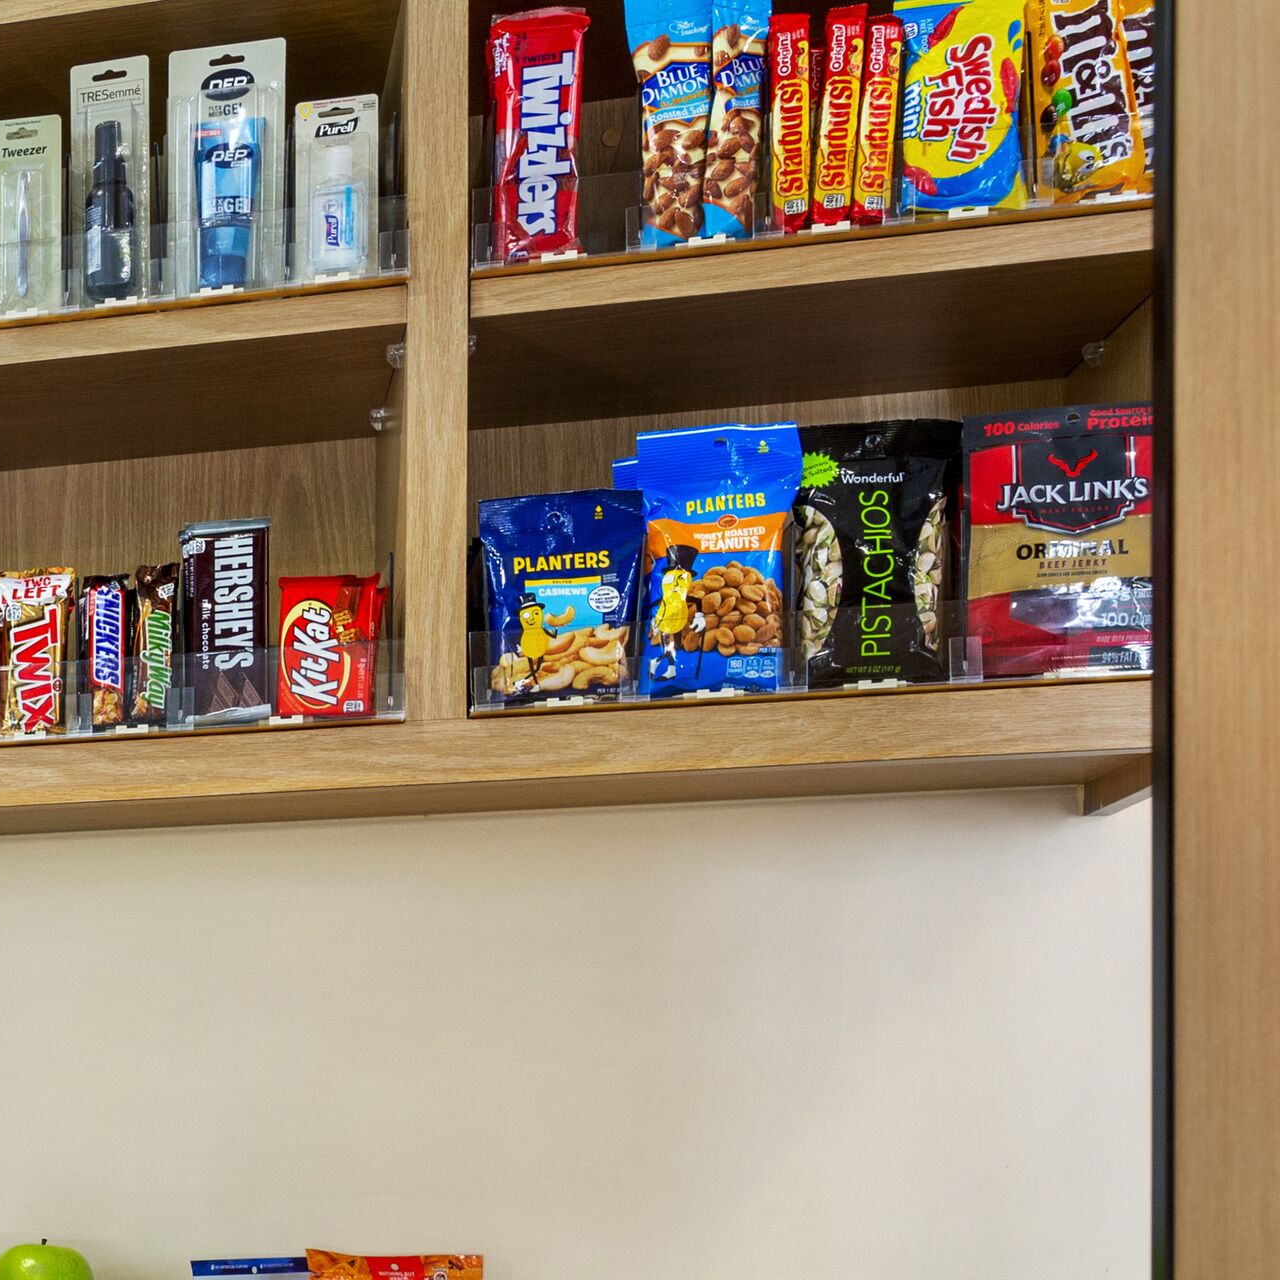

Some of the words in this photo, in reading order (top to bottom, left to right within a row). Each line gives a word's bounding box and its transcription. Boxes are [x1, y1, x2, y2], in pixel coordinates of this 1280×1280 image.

[831, 23, 845, 72] Original
[80, 83, 141, 104] TRESemmé
[920, 67, 964, 142] Fish
[947, 34, 996, 163] Swedish
[902, 81, 921, 139] mini
[318, 120, 355, 134] Purell
[821, 75, 853, 191] Starburst
[862, 77, 893, 191] Starburst
[1, 145, 47, 158] Tweezer
[983, 422, 1014, 437] 100
[1018, 419, 1060, 432] Calories
[841, 471, 903, 485] Wonderful
[686, 493, 766, 516] PLANTERS
[997, 484, 1065, 510] JACK
[1068, 477, 1148, 502] LINK'S
[694, 532, 723, 541] HONEY
[725, 527, 765, 538] ROASTED
[700, 538, 760, 551] PEANUTS
[513, 550, 610, 574] PLANTERS
[858, 490, 892, 658] PISTACHIOS
[1040, 560, 1067, 569] BEEF
[1071, 558, 1107, 568] JERKY
[215, 537, 253, 670] HERSHEY'S
[539, 588, 587, 597] CASHEWS
[12, 607, 59, 731] TWIX
